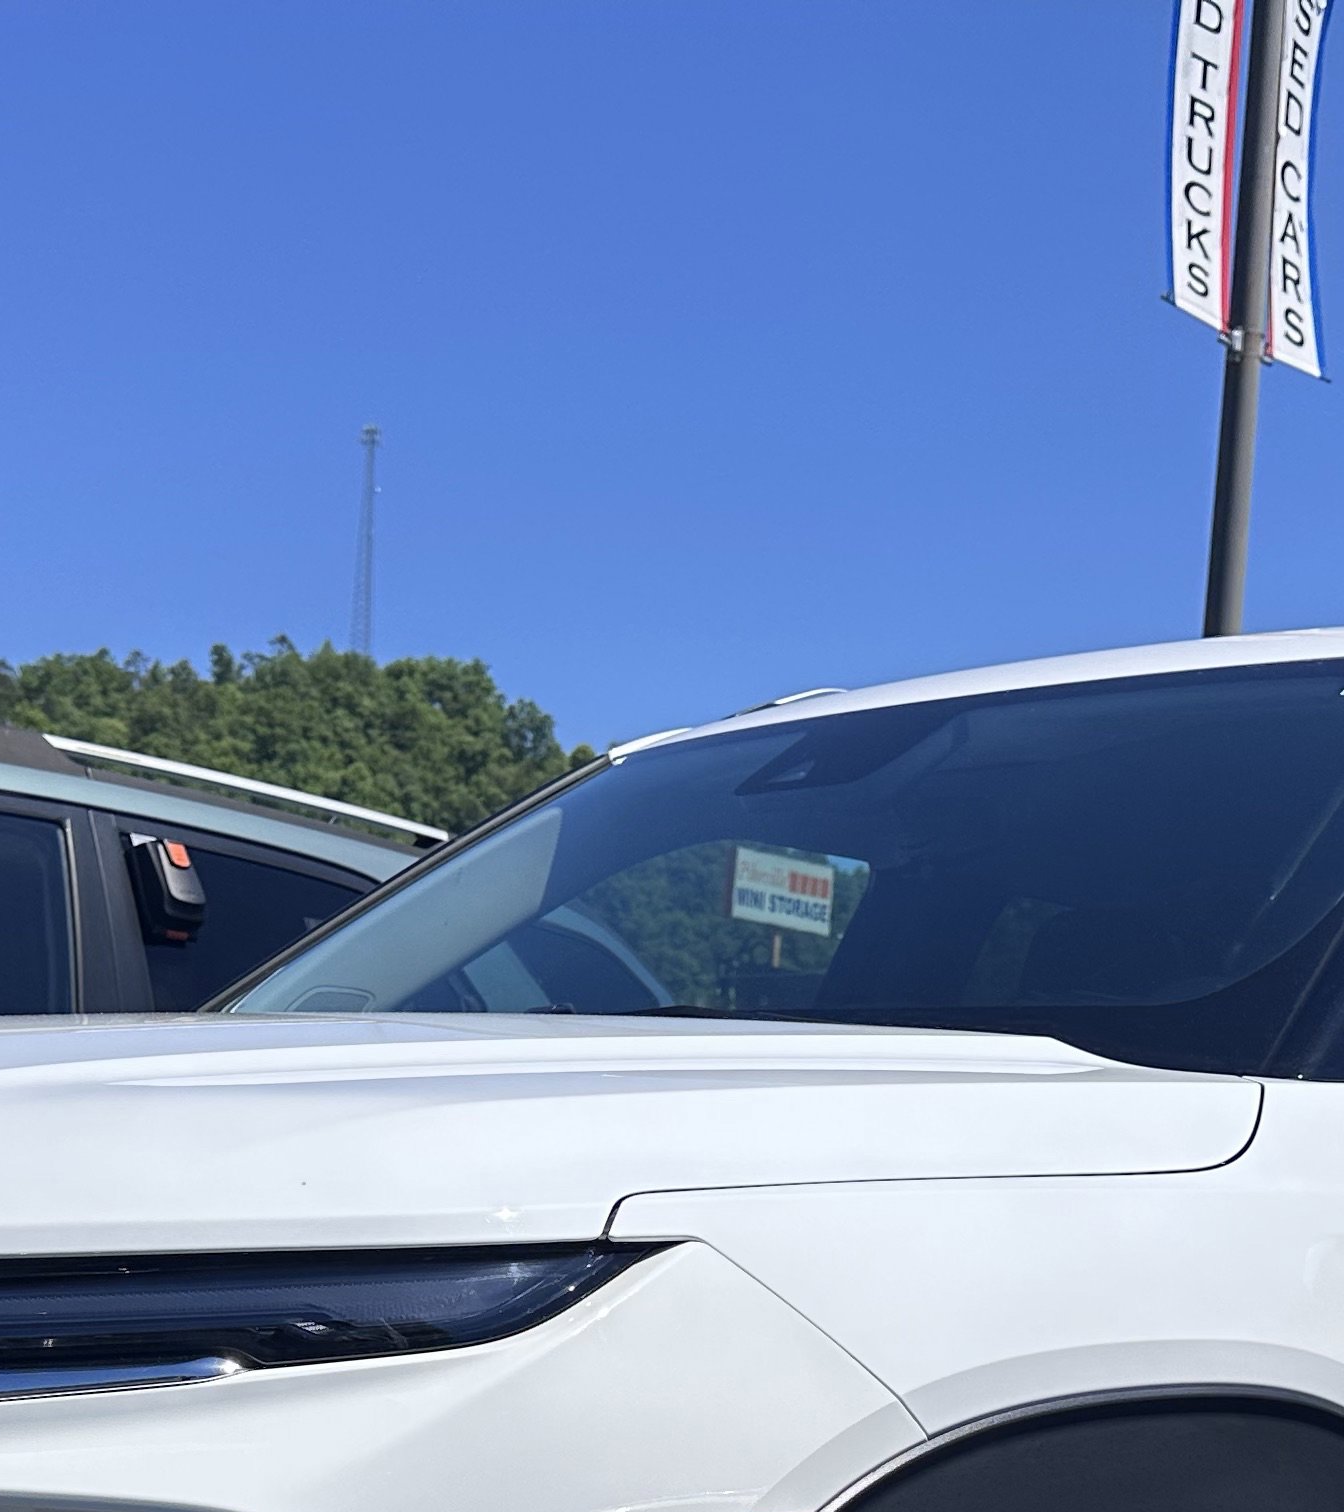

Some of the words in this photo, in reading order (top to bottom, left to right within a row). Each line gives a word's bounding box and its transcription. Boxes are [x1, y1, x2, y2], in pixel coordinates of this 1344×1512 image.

[1183, 52, 1219, 297] TRUCKS
[1279, 160, 1305, 347] CARS
[767, 894, 828, 924] STORAGE
